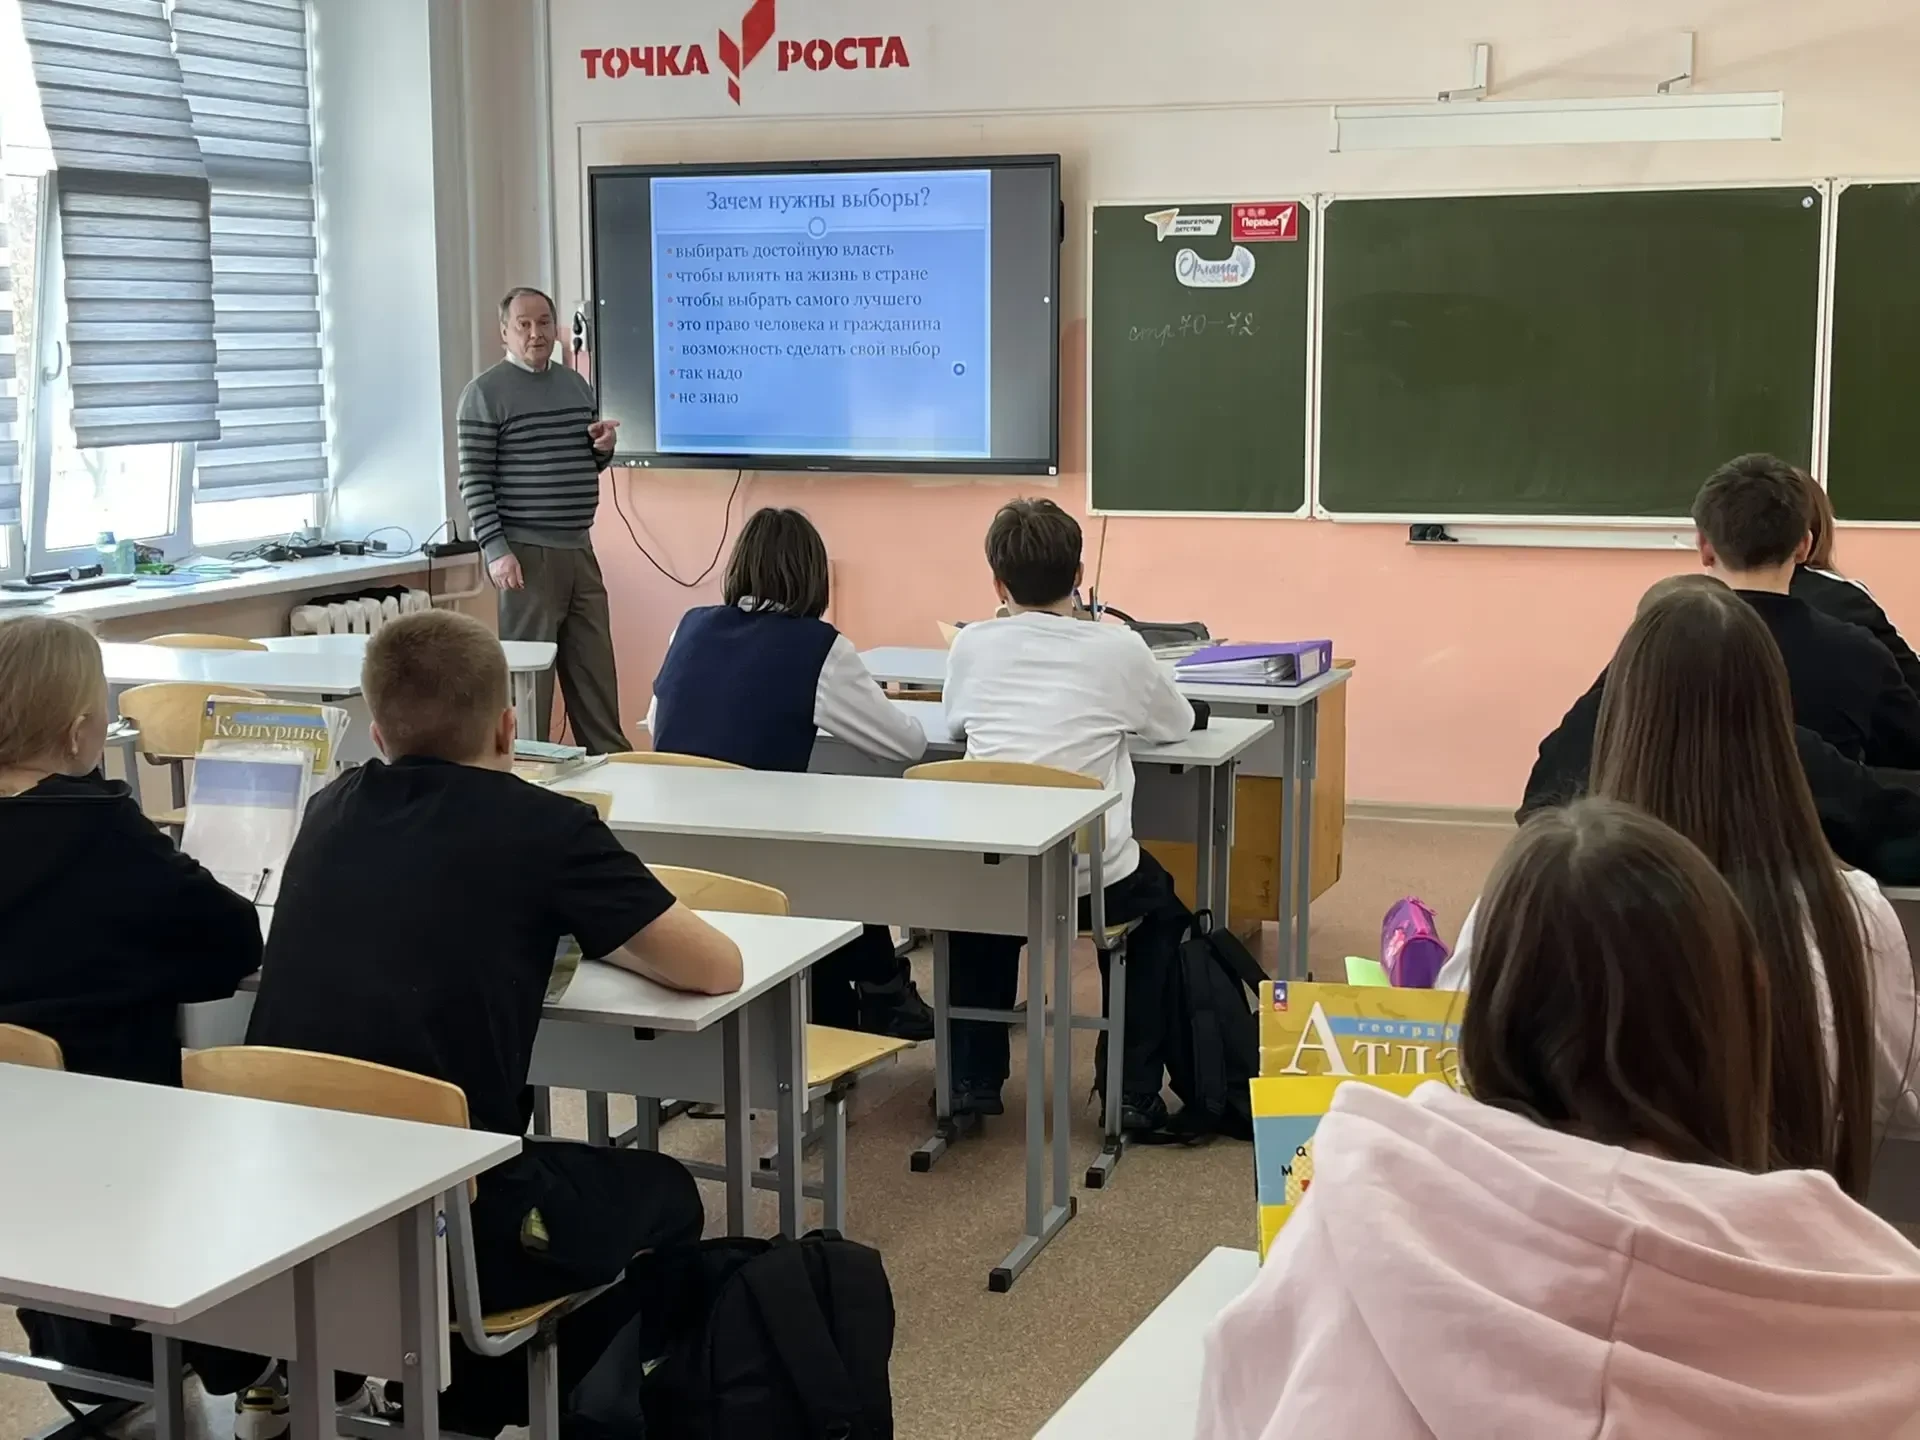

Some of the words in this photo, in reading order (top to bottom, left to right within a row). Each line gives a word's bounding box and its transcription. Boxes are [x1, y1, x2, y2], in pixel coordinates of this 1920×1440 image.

[580, 44, 710, 79] ТОЧКА
[777, 36, 910, 71] РОСТА
[706, 191, 762, 210] Зачем
[768, 194, 835, 213] нужны
[842, 187, 931, 212] выборы?
[675, 243, 749, 261] выбирать
[752, 242, 838, 260] достойную
[842, 243, 894, 257] власть
[675, 267, 723, 282] чтобы
[727, 270, 781, 282] влиять
[785, 271, 803, 282] на
[807, 270, 858, 281] жизнь
[862, 270, 871, 281] в
[875, 268, 929, 284] стране
[676, 293, 724, 307] чтобы
[727, 292, 792, 310] выбрать
[795, 295, 850, 307] самого
[853, 294, 922, 310] лучшего
[676, 319, 701, 332] это
[705, 319, 750, 335] право
[753, 319, 825, 332] человека
[829, 320, 839, 331] и
[843, 318, 941, 334] гражданина
[681, 343, 783, 356] возможность
[786, 343, 847, 358] сделать
[850, 340, 886, 356] свой
[890, 341, 941, 358] выбор
[678, 367, 703, 380] так
[706, 367, 743, 381] надо
[678, 392, 697, 404] не
[700, 392, 739, 404] знаю
[214, 715, 328, 742] Контурные
